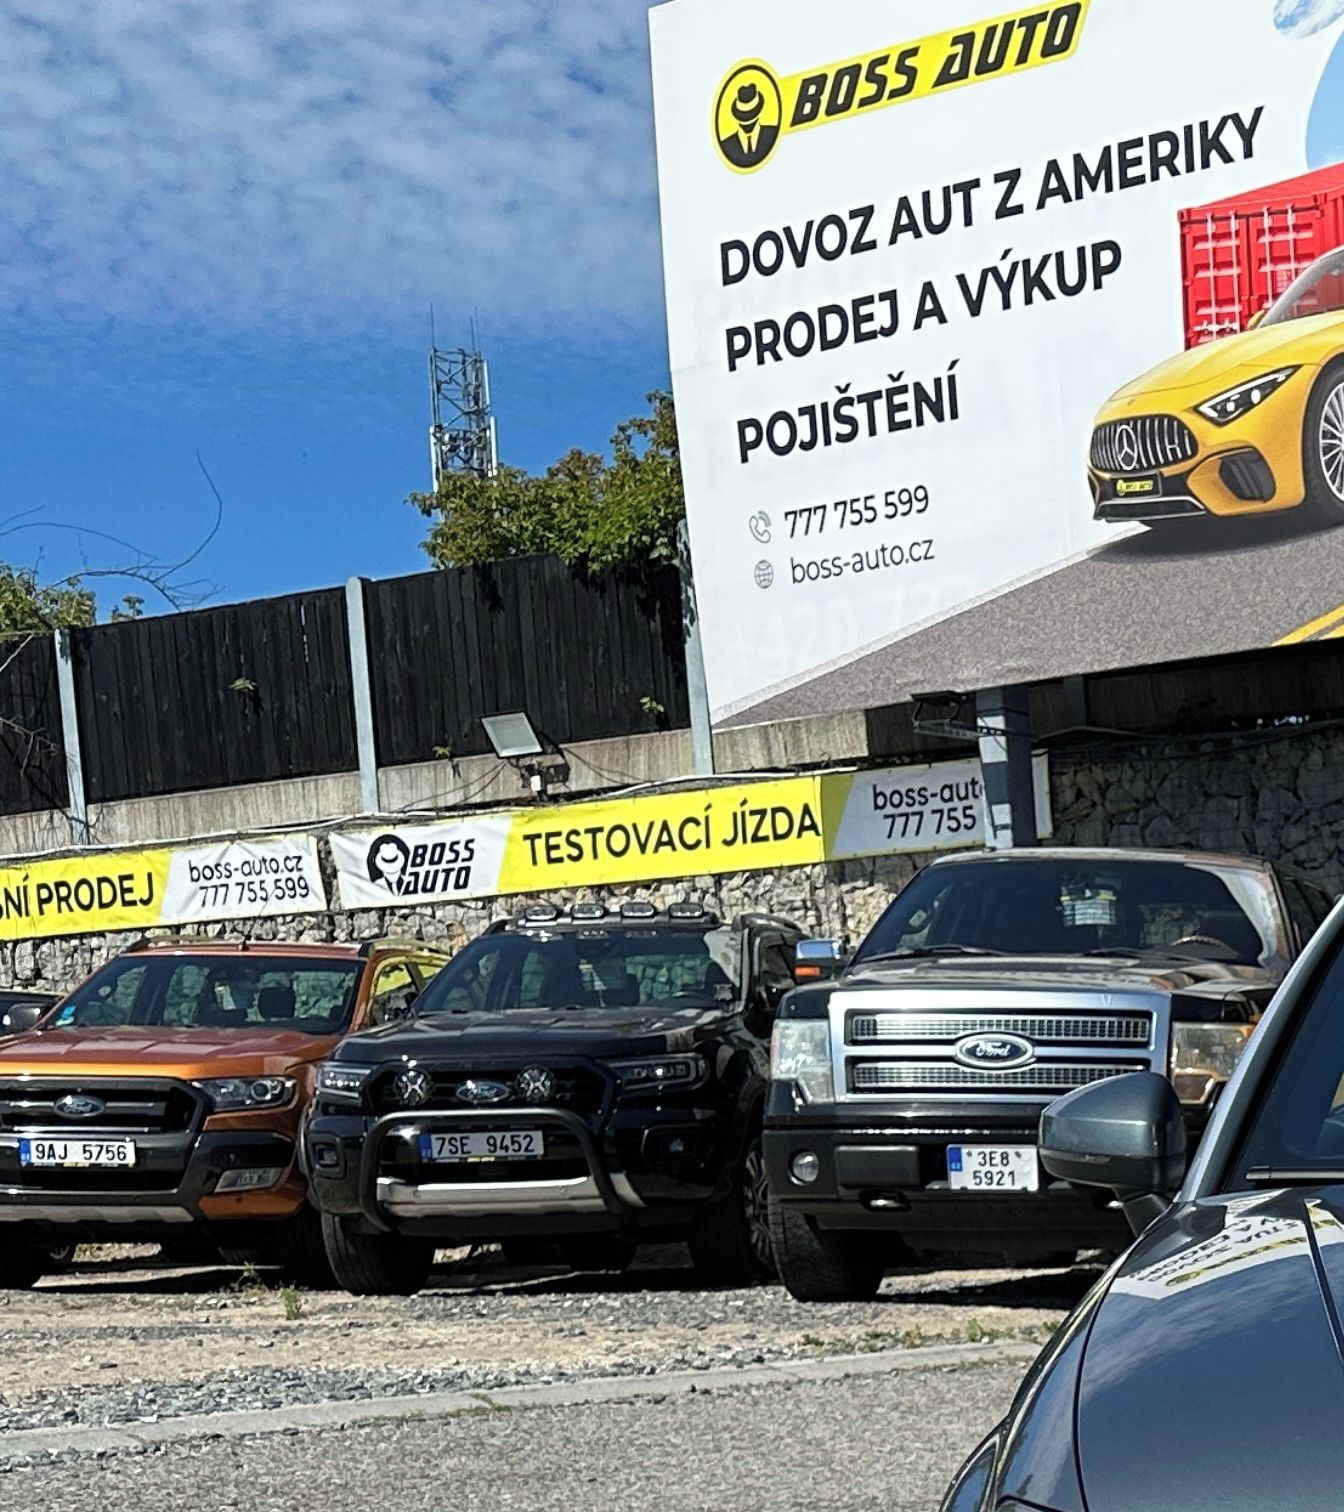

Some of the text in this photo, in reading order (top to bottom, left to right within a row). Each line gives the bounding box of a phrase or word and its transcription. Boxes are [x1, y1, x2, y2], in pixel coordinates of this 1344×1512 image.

[790, 2, 1082, 127] BOSS AUTO
[720, 105, 1265, 286] DOVOZ AUT Z AMERIKY
[726, 240, 1122, 372] PRODEJ A VÝKUP
[737, 359, 960, 464] POJIŠTĚNÍ
[784, 485, 929, 539] 777 755 599
[790, 539, 935, 584] boss-auto.cz
[523, 798, 821, 866] TESTOVACÍ JÍZDA
[883, 805, 977, 839] 777 755
[188, 855, 304, 883] boss-auto.cz
[410, 838, 476, 868] BOSS
[0, 872, 155, 920] NÍ PRODEJ
[199, 875, 309, 907] 777 755 599
[402, 866, 472, 895] AUTO
[35, 1143, 68, 1160] 9AJ
[82, 1144, 127, 1161] 5756
[435, 1136, 471, 1155] 7SE
[486, 1134, 535, 1154] 9452
[977, 1151, 1010, 1167] 3E8
[972, 1170, 1016, 1186] 5921
